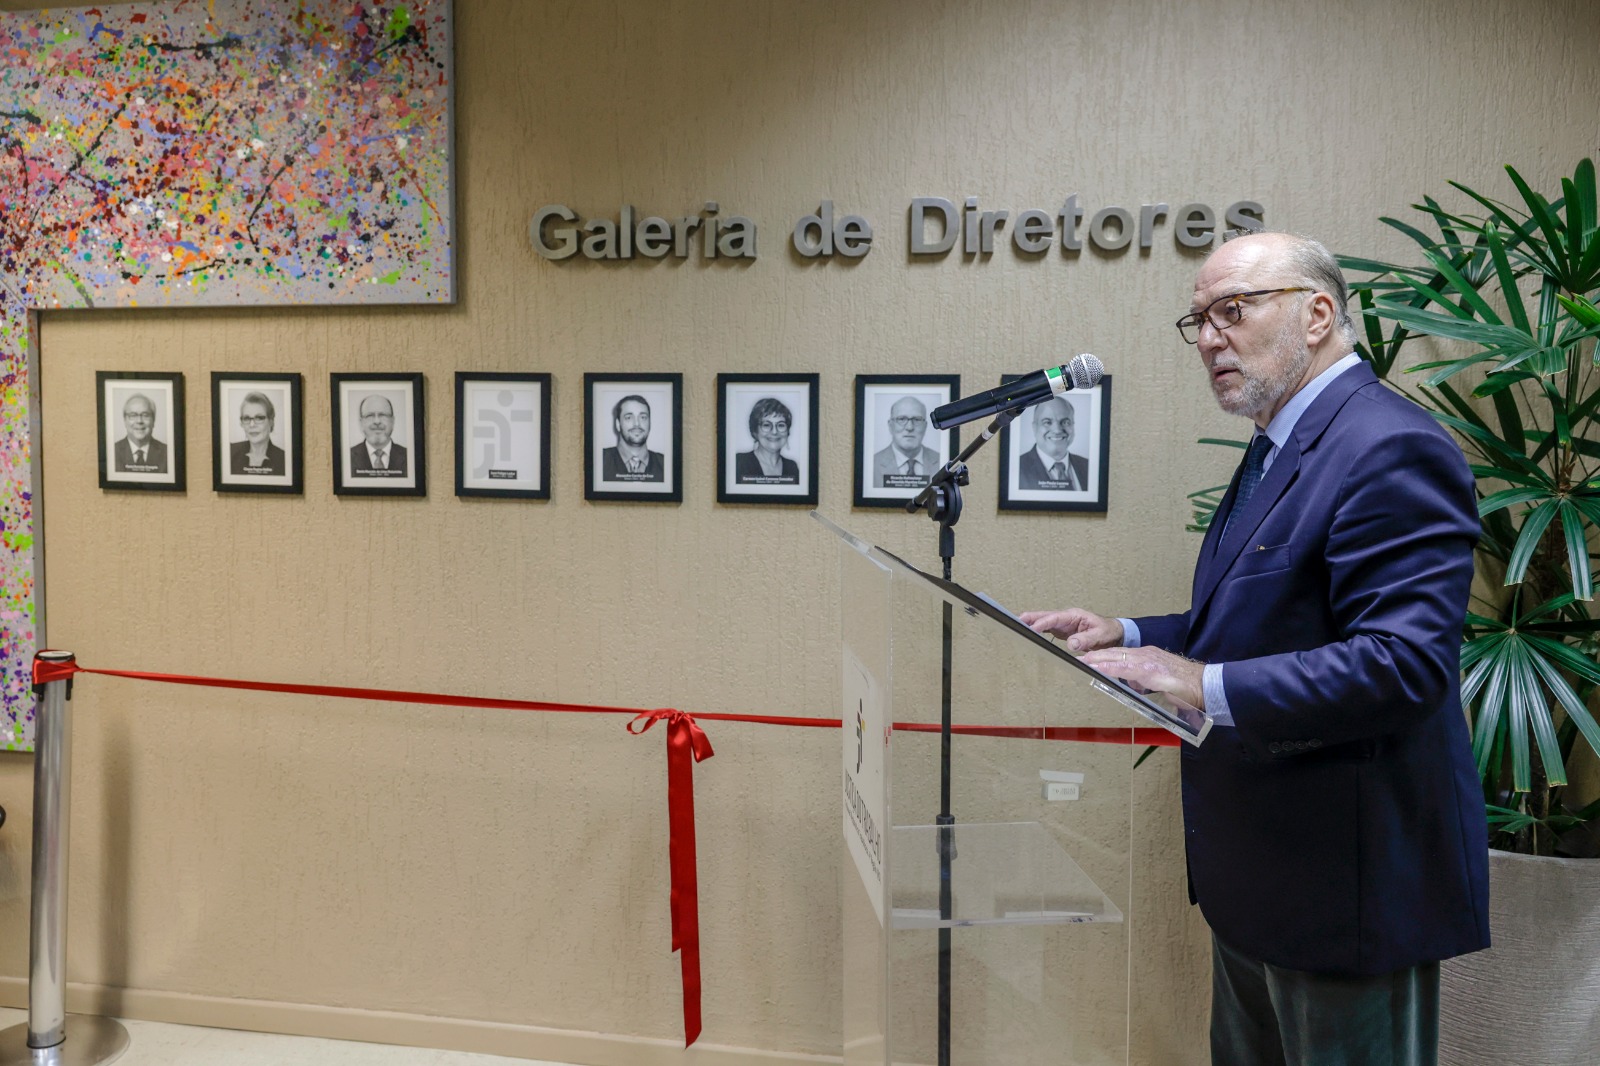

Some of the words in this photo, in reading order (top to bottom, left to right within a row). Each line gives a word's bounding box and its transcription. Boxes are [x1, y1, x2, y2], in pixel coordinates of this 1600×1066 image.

[530, 200, 757, 260] Galeria
[793, 199, 873, 257] de
[910, 192, 1264, 254] Diretores
